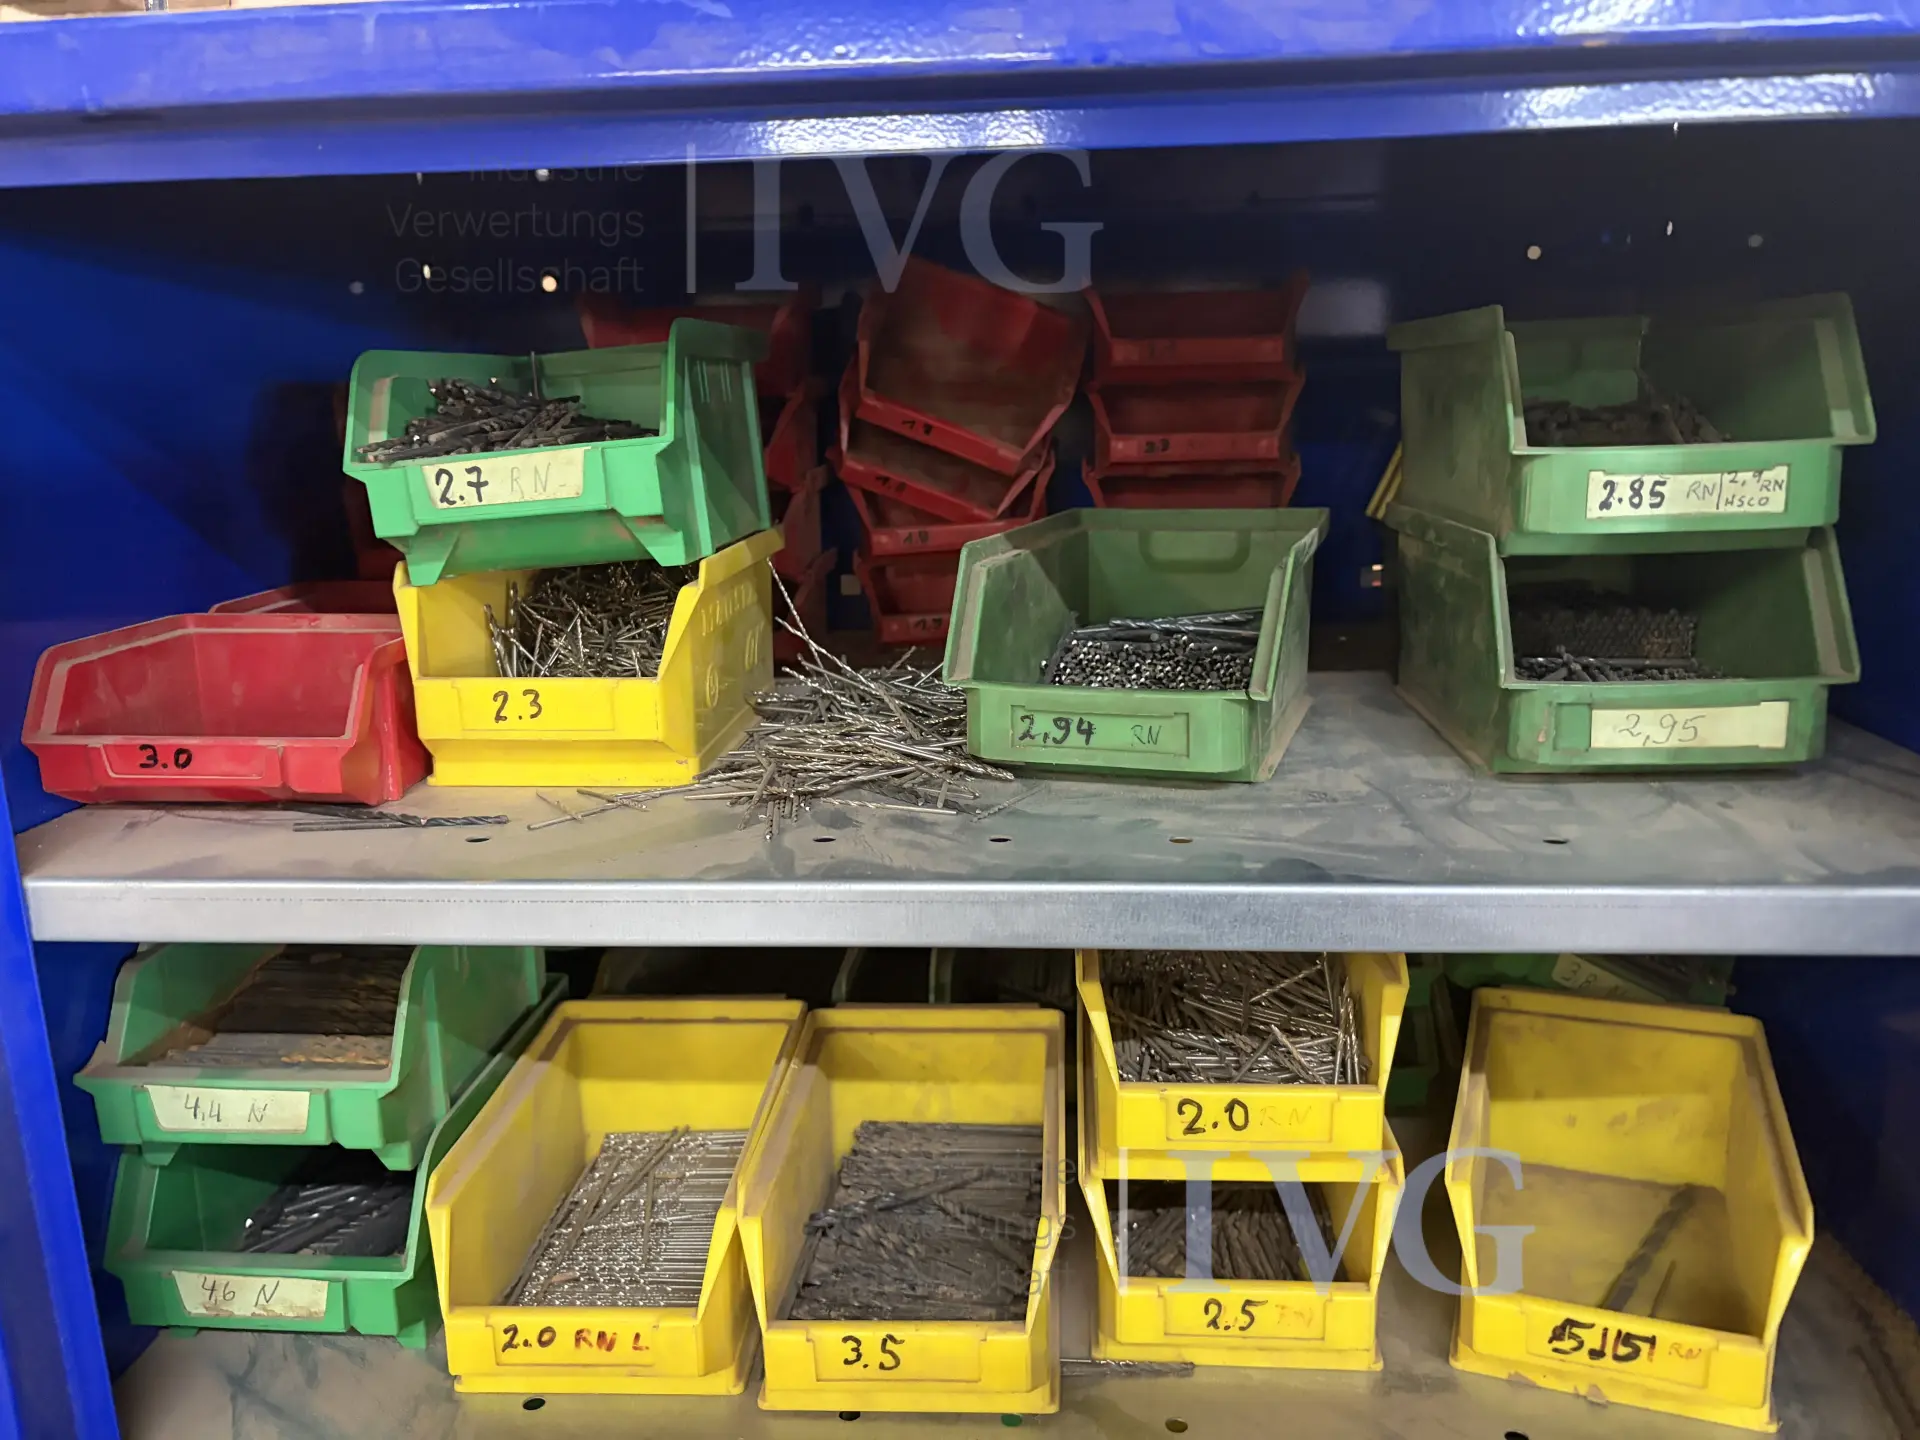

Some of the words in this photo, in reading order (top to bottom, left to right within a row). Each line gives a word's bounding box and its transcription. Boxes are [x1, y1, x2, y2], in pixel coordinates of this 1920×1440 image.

[435, 465, 489, 506] 2.7
[1598, 479, 1667, 511] 2.85
[1686, 481, 1716, 500] RN
[1759, 479, 1785, 493] RN
[492, 688, 543, 724] 2.3
[1130, 724, 1162, 746] RN
[1618, 713, 1707, 746] 2,95
[138, 744, 193, 769] 3.0
[1177, 1097, 1250, 1136] 2.0
[254, 1280, 280, 1307] N
[1203, 1298, 1269, 1332] 2.5
[501, 1323, 557, 1353] 2.0
[574, 1328, 618, 1352] RN
[841, 1333, 905, 1371] 3.5
